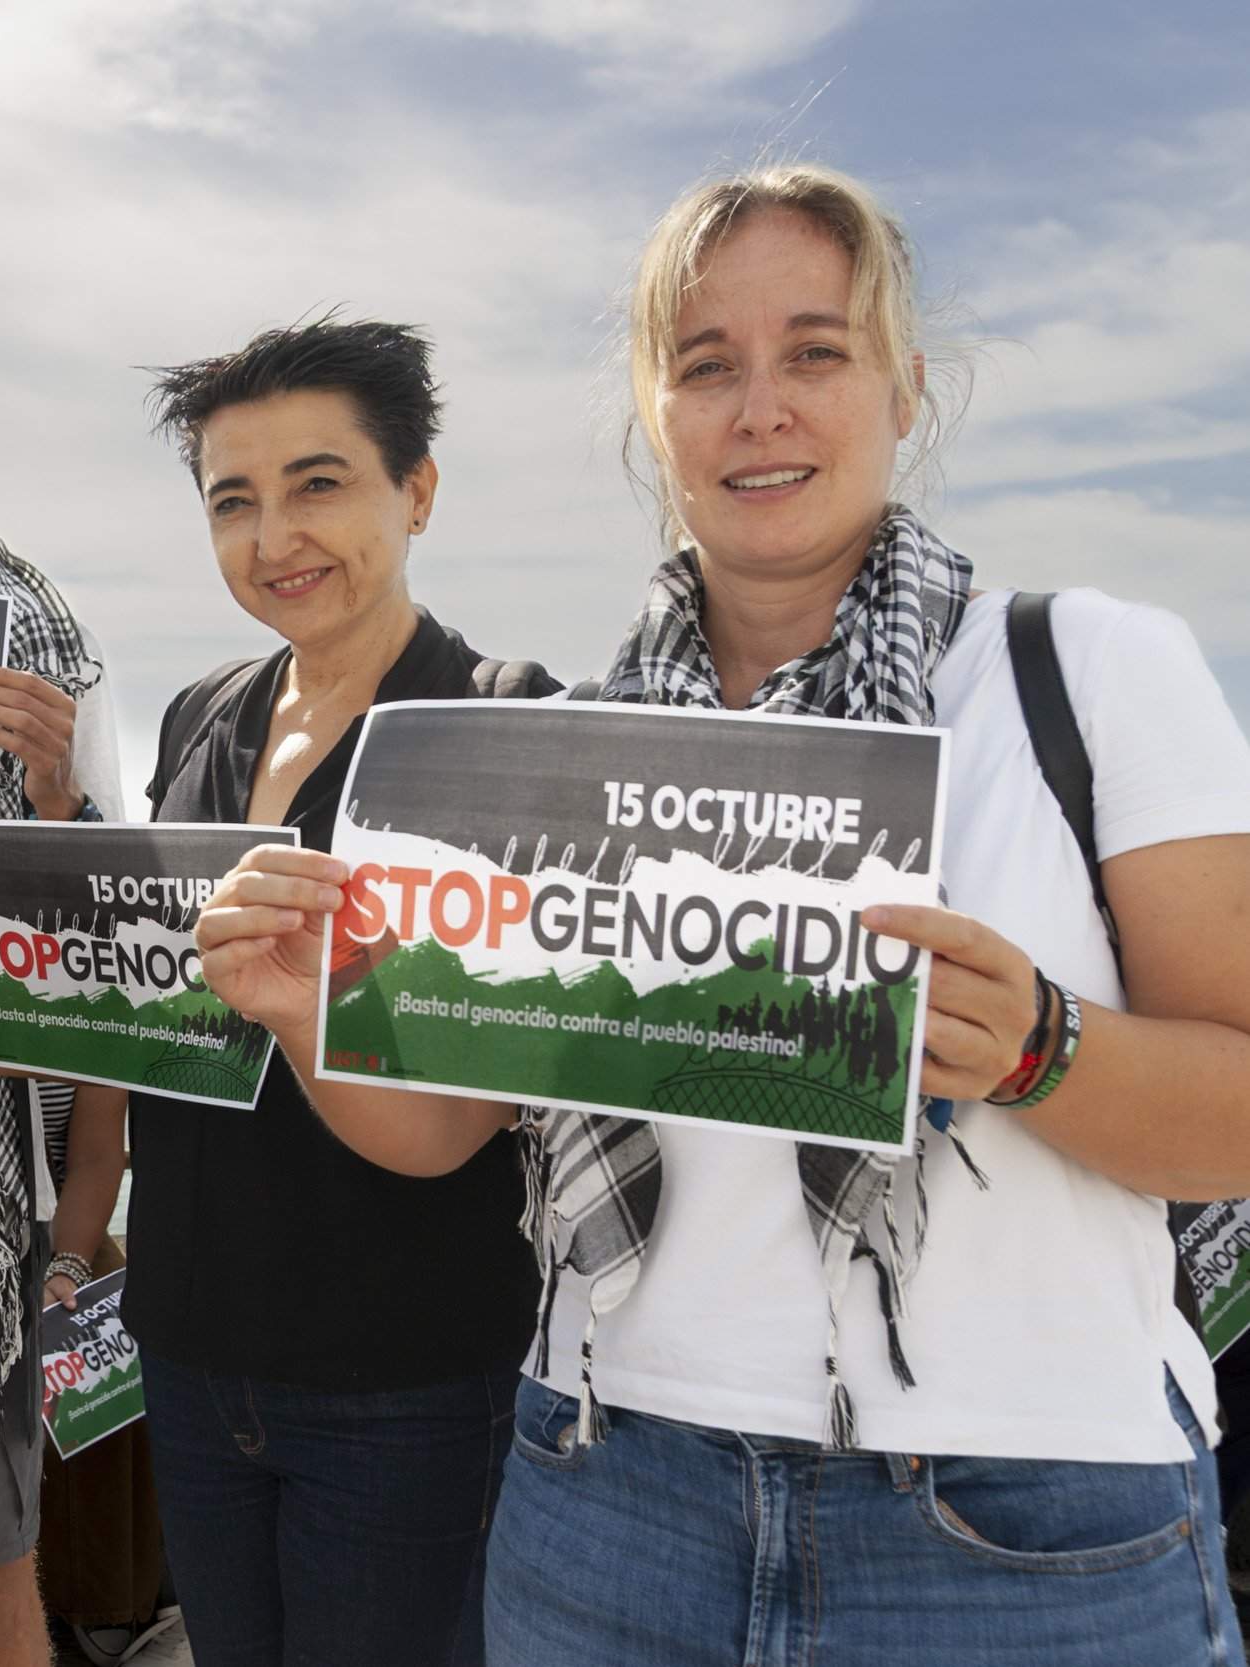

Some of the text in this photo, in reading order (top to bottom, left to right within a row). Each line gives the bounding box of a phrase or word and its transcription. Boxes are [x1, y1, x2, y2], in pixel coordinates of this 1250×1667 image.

[604, 781, 863, 844] 15 OCTUBRE
[88, 874, 222, 909] 15 OCTUB
[26, 1009, 37, 1024] al
[38, 1013, 90, 1029] genocidio
[91, 1018, 127, 1034] contra
[128, 1021, 138, 1037] el
[139, 1025, 175, 1042] pueblo
[176, 1029, 228, 1050] palestino!
[393, 991, 805, 1057] ¡Basta al genocidio contra el pueblo palestino!
